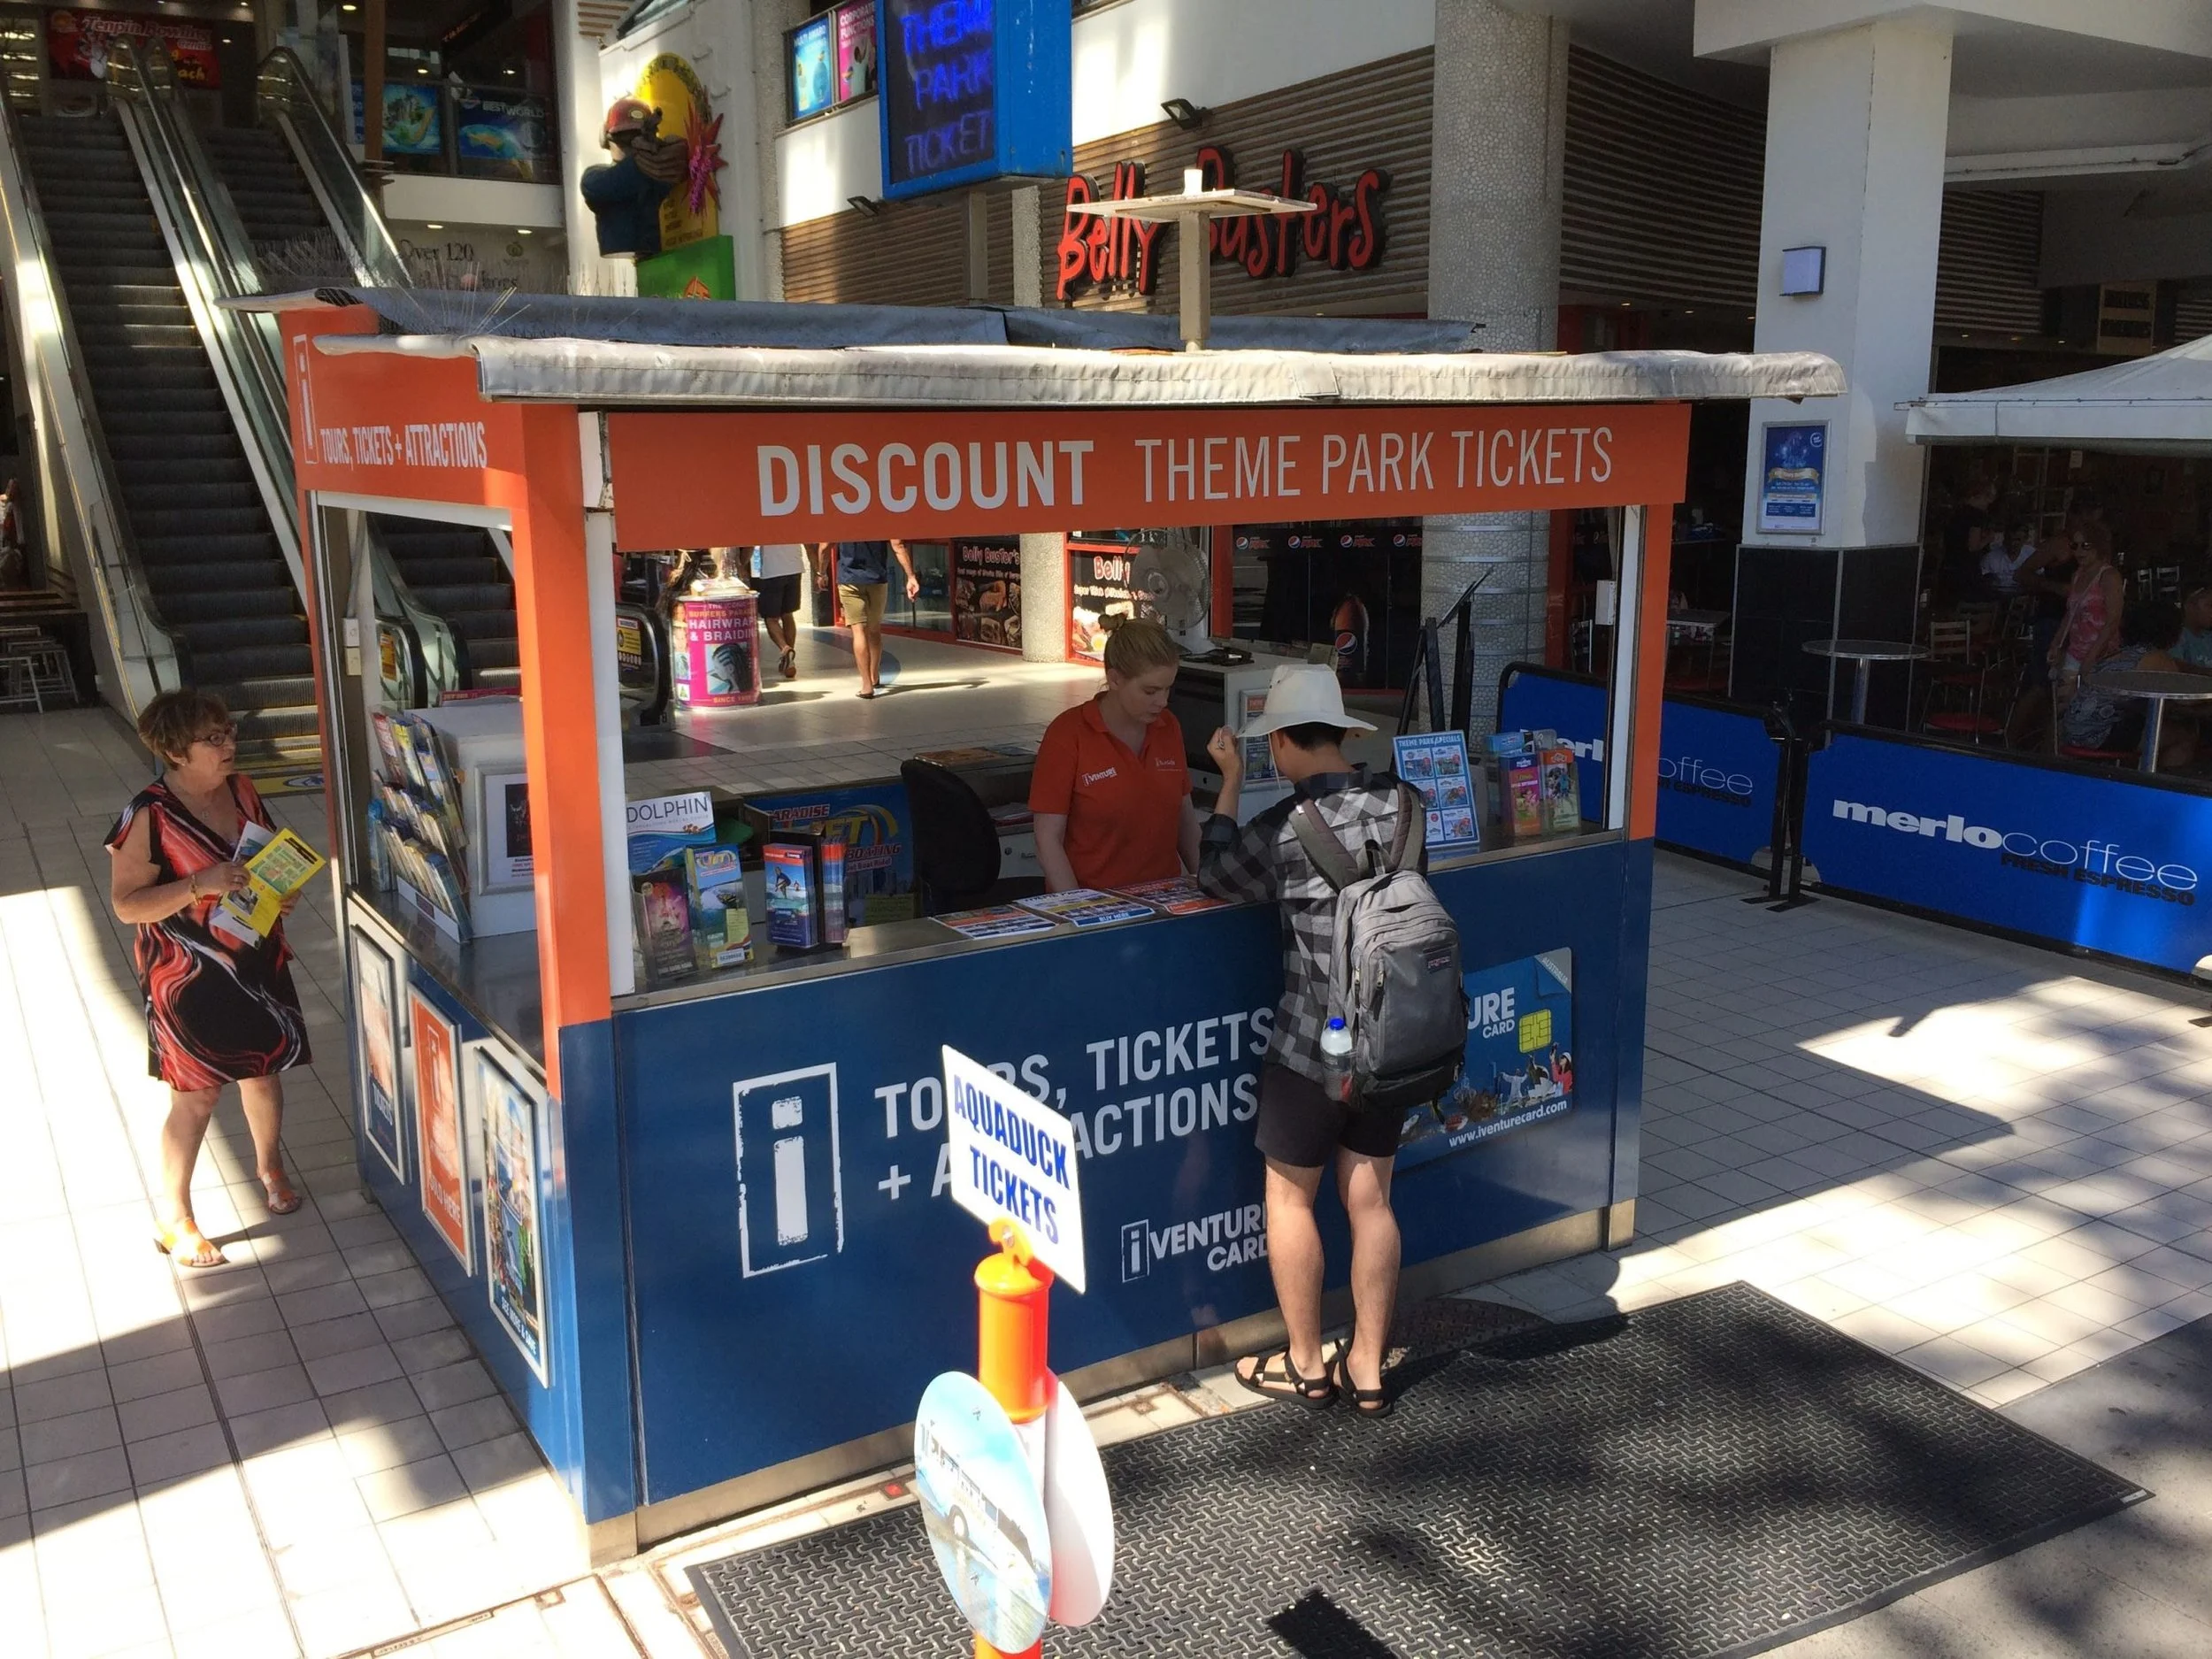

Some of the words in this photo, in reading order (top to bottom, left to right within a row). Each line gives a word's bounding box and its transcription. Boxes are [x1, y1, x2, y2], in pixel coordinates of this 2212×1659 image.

[1056, 160, 1162, 302] Belly
[319, 427, 354, 472] TOURS,
[352, 425, 395, 466] TICKETS
[404, 421, 488, 469] ATTRACTIONS
[757, 440, 1094, 517] DISCOUNT
[1135, 434, 1301, 503] THEME
[1322, 431, 1434, 495] PARK
[1451, 426, 1613, 488] TICKETS
[1418, 737, 1433, 746] PARK
[1434, 734, 1462, 746] SPECIALS
[1657, 757, 1754, 795] offee
[626, 796, 709, 824] DOLPHIN
[2001, 852, 2070, 878] FRESH
[2073, 867, 2195, 907] ESPRESSO
[1482, 1018, 1516, 1040] CARD
[874, 1054, 1067, 1140] TOS,
[1086, 1007, 1275, 1091] TICKETS
[878, 1164, 911, 1201] +
[931, 1072, 1258, 1198] ACTIONS
[953, 1073, 1071, 1191] AQUADUCK
[1448, 1098, 1568, 1148] www.iventurecard.com
[969, 1143, 1060, 1246] TICKETS
